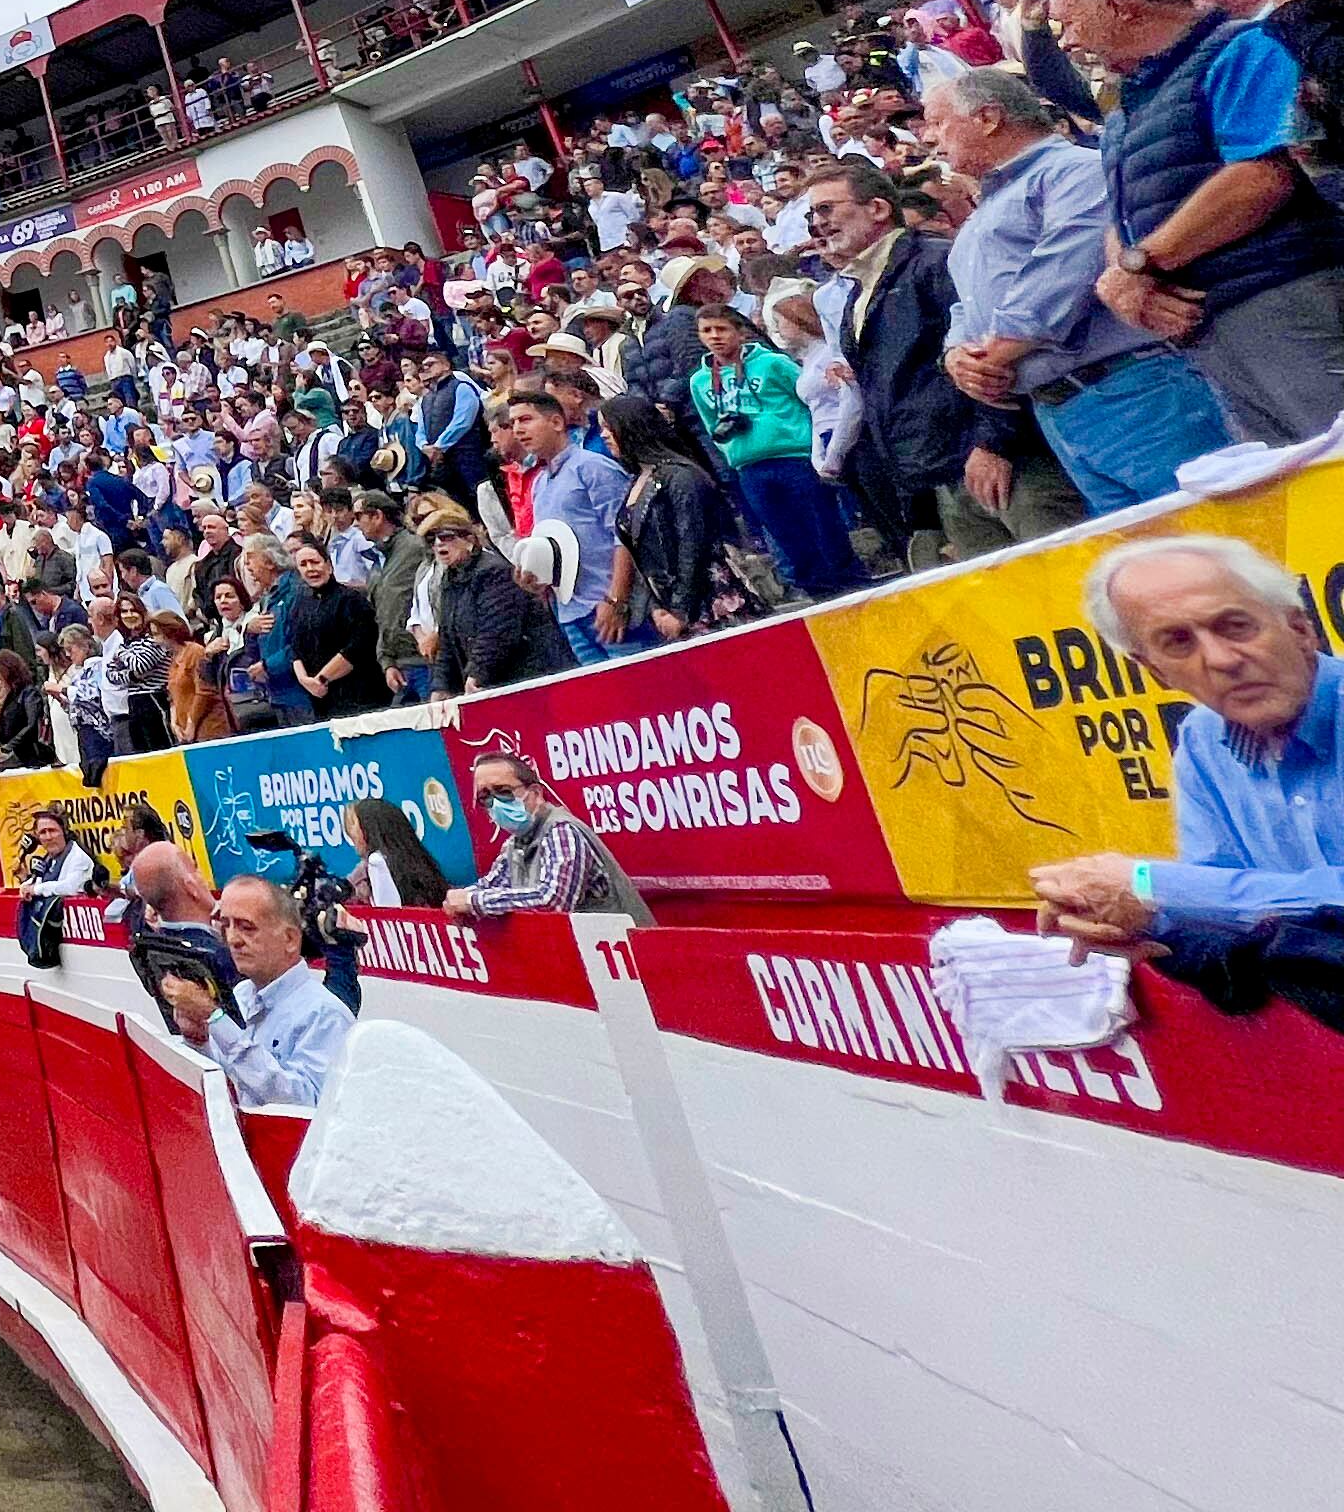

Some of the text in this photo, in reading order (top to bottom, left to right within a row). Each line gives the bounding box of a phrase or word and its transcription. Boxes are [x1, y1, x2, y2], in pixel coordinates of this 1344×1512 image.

[11, 219, 35, 246] 69
[546, 702, 741, 781] BRINDAMOS
[1075, 708, 1156, 757] POR
[259, 761, 385, 807] BRINDAMOS
[582, 784, 617, 811] POR
[617, 763, 802, 833] SONRISAS
[1120, 756, 1170, 801] EL
[280, 808, 305, 829] POR
[590, 809, 622, 834] LAS
[595, 939, 639, 981] 11
